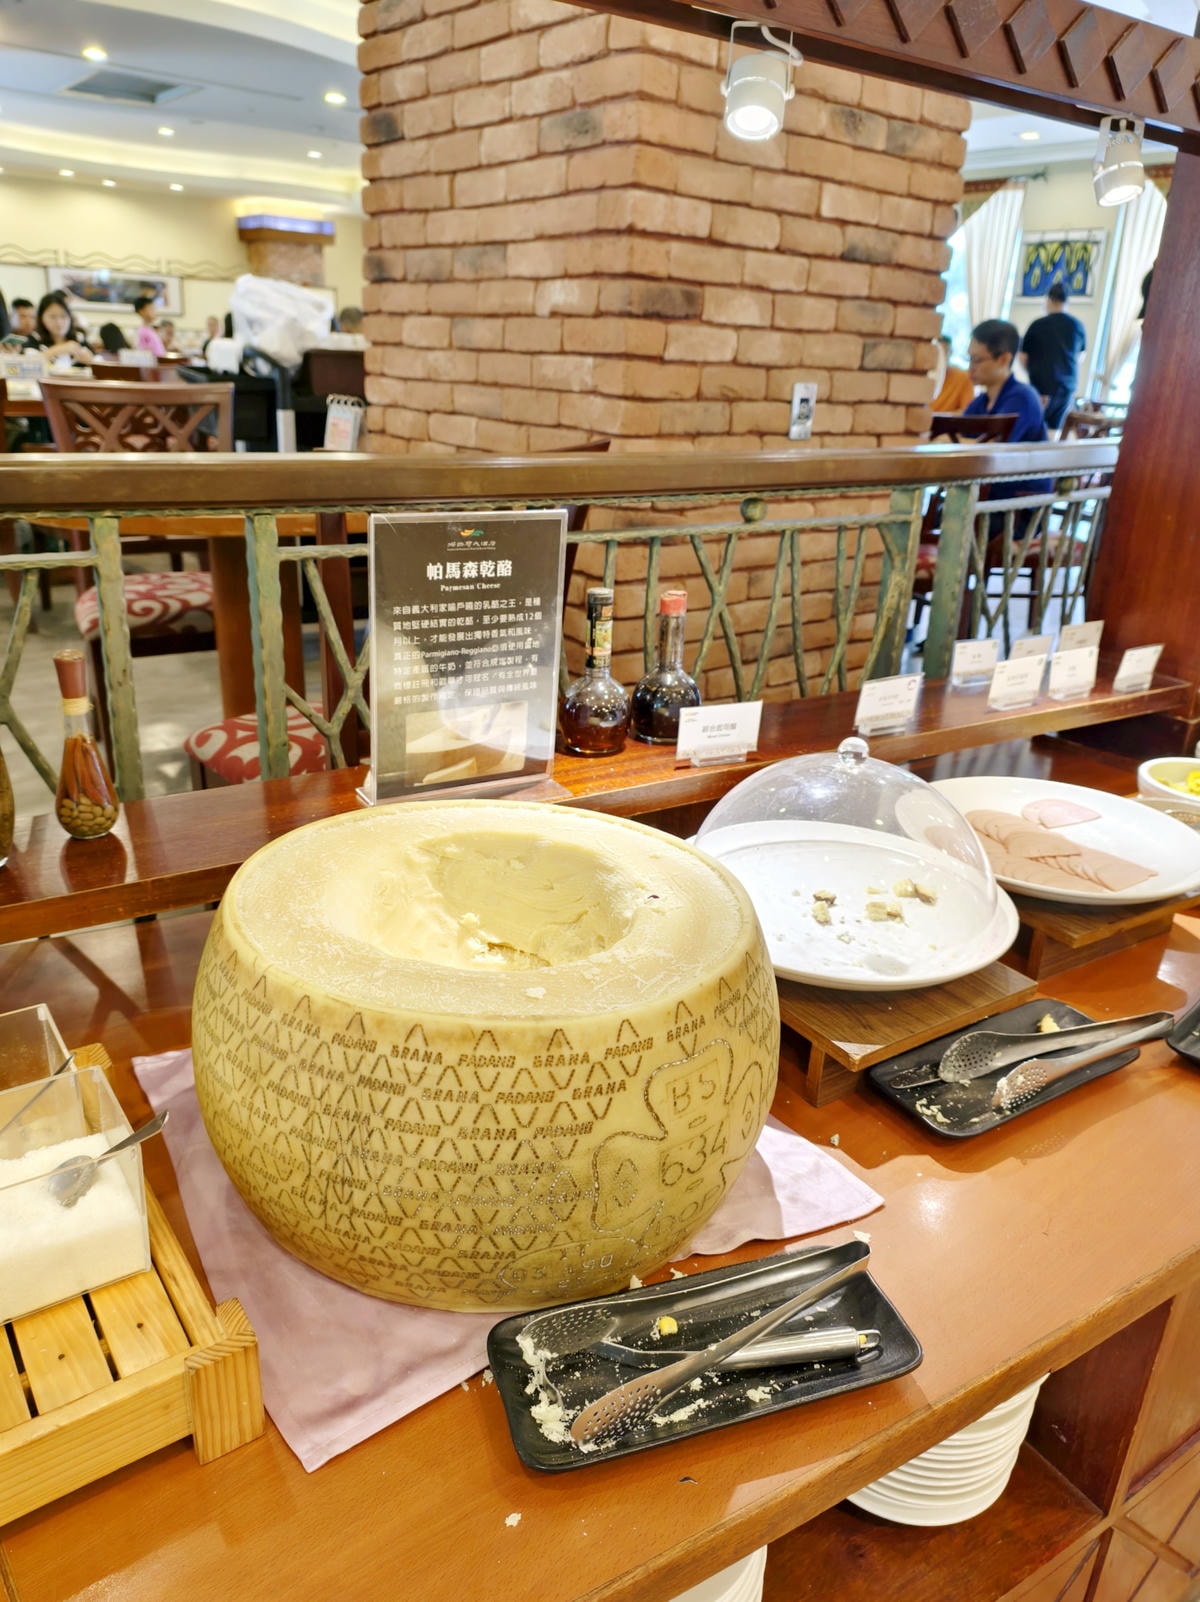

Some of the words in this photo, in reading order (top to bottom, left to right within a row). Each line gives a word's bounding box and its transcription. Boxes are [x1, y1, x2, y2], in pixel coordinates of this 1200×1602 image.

[427, 560, 512, 580] 帕馬森乾酪
[440, 583, 475, 592] Parmesan
[476, 582, 501, 590] Cheese
[281, 1012, 321, 1039] GRANA
[331, 1032, 378, 1053] PADANO
[391, 1044, 443, 1065] GRANA
[457, 1053, 516, 1069] PADANO
[532, 1051, 590, 1068] GRANA
[604, 1037, 654, 1061] PADANO
[666, 1015, 706, 1043] GRANA
[226, 1049, 258, 1081] GRANA
[266, 1079, 311, 1108] PADANO
[322, 1103, 371, 1126] GRANA
[384, 1118, 441, 1137] PADANO
[457, 1127, 517, 1141] GRANA
[533, 1121, 594, 1140] PADANO
[299, 1058, 346, 1082] GRANA
[357, 1075, 407, 1097] PADANO
[421, 1088, 479, 1104] GRANA
[495, 1090, 555, 1104] PADANO
[572, 1079, 627, 1101] GRANA
[240, 1096, 278, 1128] GRANA
[661, 1119, 728, 1187] 634
[419, 1220, 479, 1235] GRANA
[457, 1249, 517, 1260] GRANA
